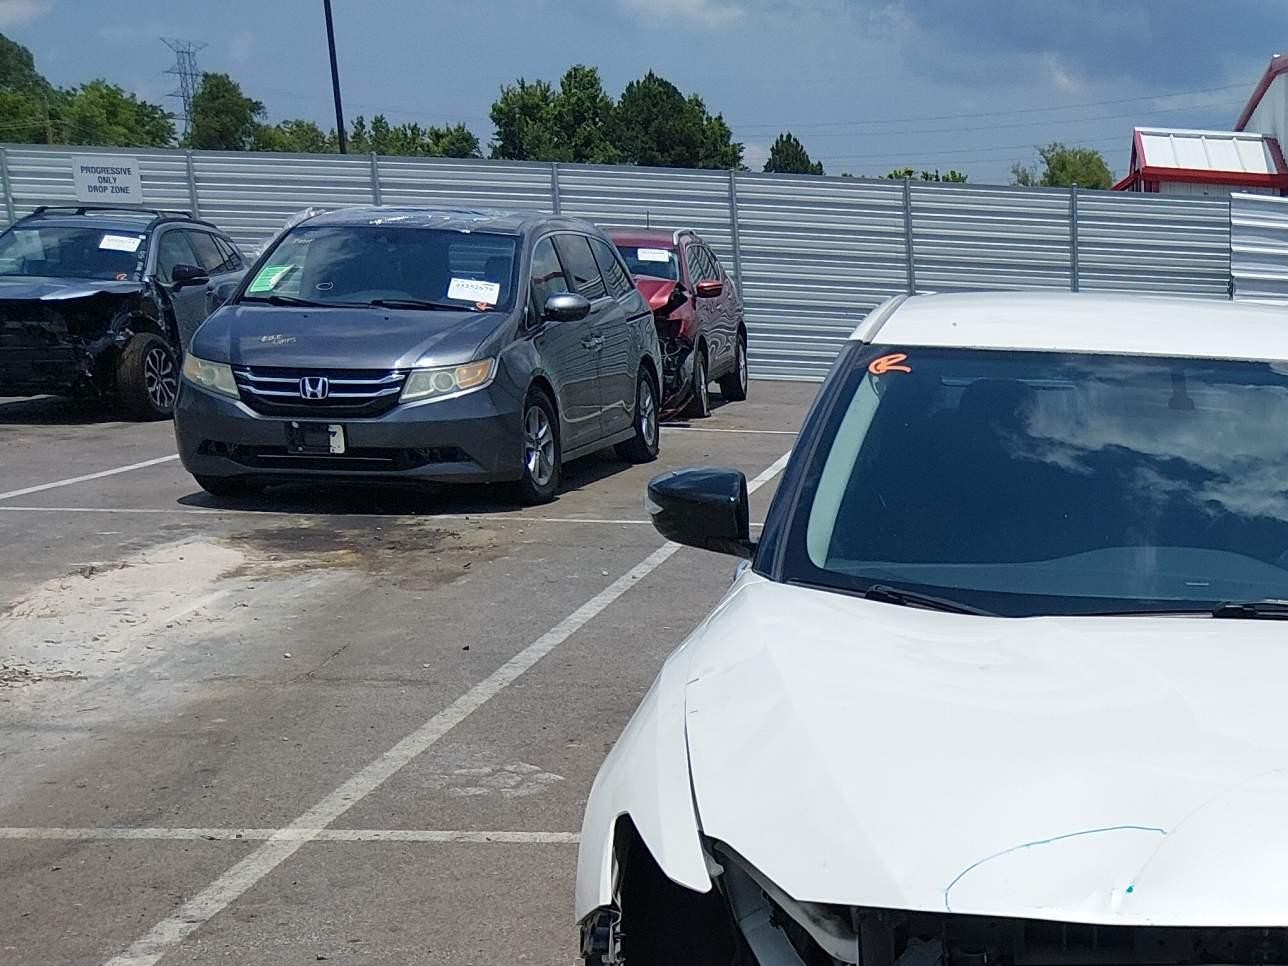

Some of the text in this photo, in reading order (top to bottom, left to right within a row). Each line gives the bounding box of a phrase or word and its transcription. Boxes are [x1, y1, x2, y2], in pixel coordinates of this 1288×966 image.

[80, 166, 132, 175] PROGRESSIVE
[97, 176, 117, 184] ONLY
[88, 185, 130, 194] DROP ZONE
